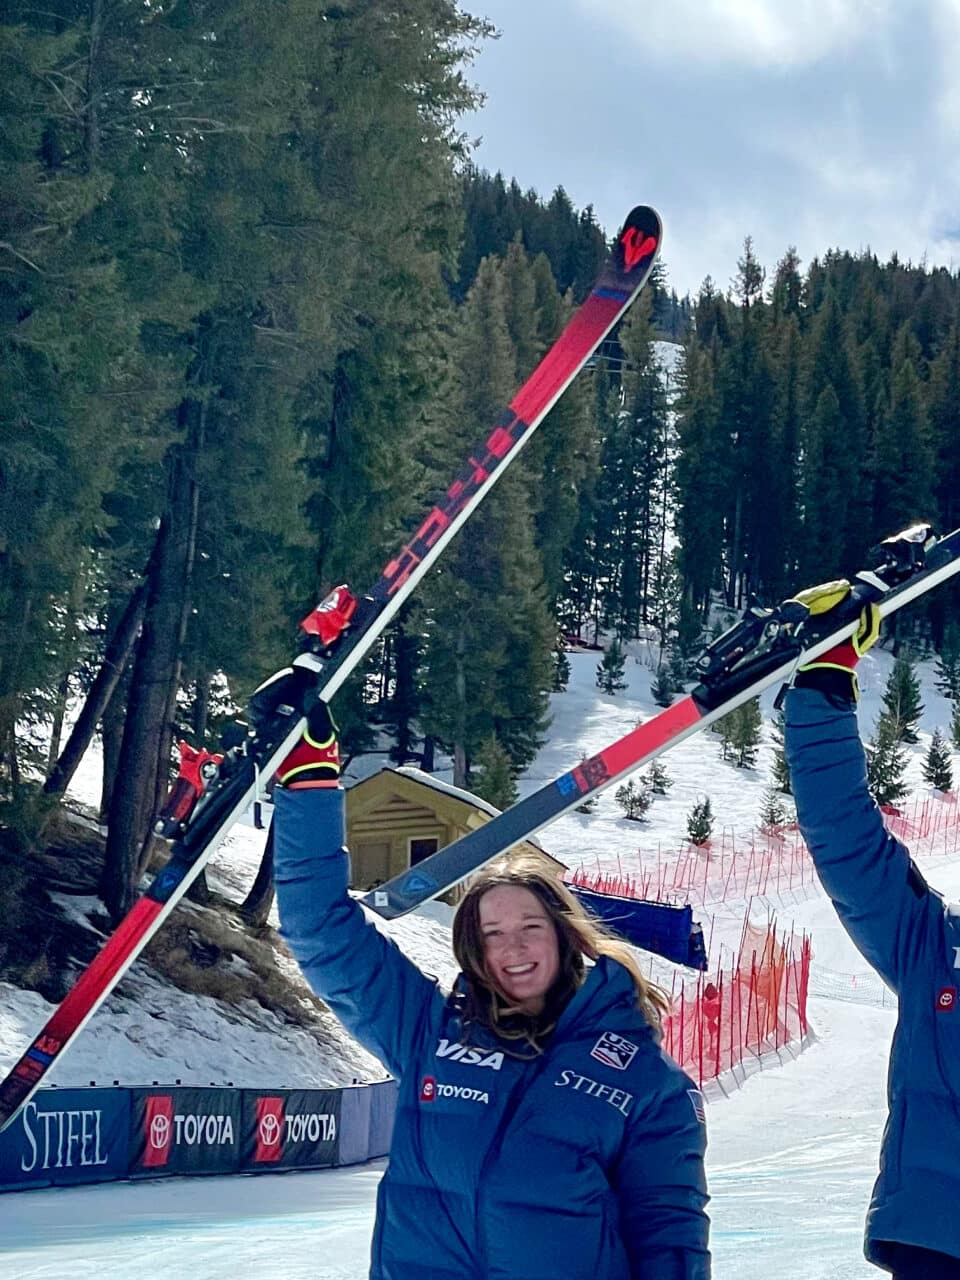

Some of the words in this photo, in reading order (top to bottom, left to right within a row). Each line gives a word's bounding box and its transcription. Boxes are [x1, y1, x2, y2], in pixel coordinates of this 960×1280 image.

[435, 1039, 505, 1071] VISA
[604, 1032, 637, 1054] US
[436, 1084, 489, 1104] TOYOTA
[555, 1070, 633, 1117] STIFEL
[21, 1101, 107, 1172] STIFEL
[174, 1114, 233, 1145] TOYOTA
[285, 1114, 336, 1142] TOYOTA
